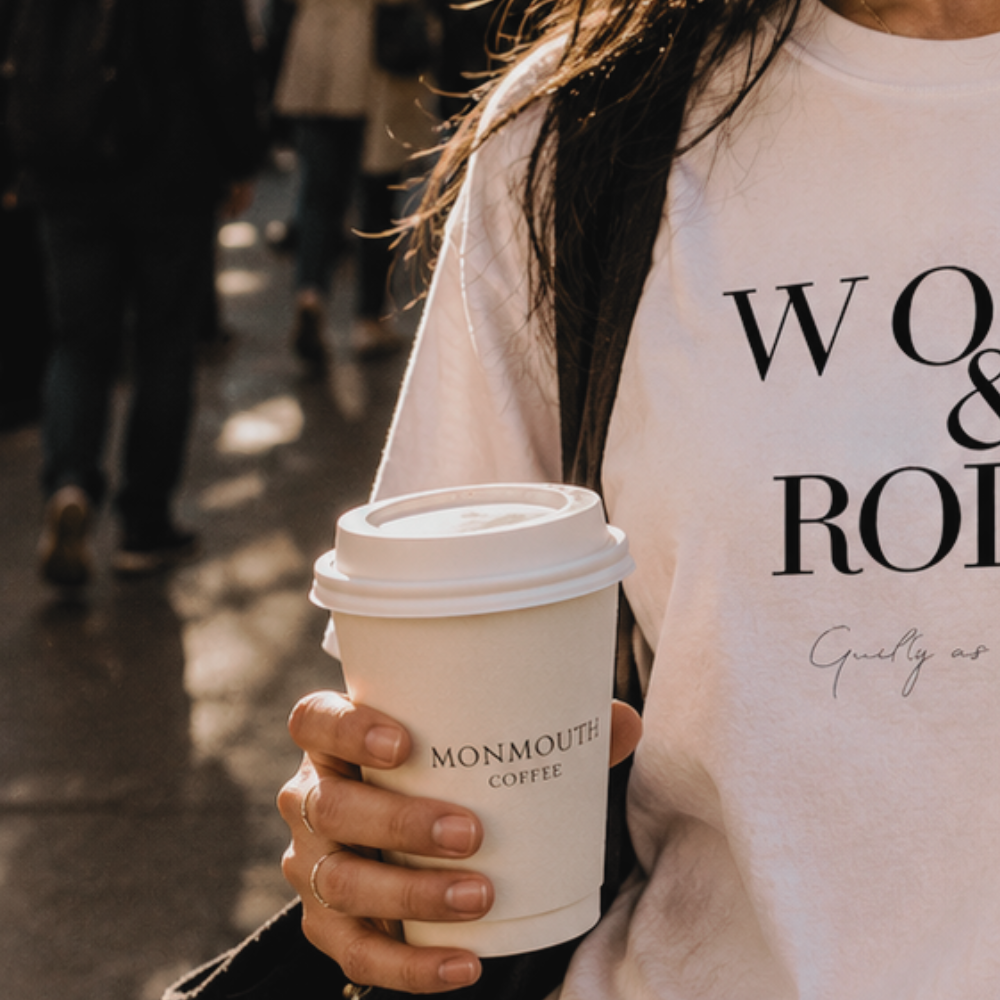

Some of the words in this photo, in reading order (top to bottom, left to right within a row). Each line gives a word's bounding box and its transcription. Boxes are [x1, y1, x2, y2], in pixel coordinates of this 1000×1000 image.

[809, 624, 935, 699] Guilty
[951, 644, 990, 660] as
[430, 716, 600, 769] MONMOUTH
[487, 762, 563, 789] COFFEE
